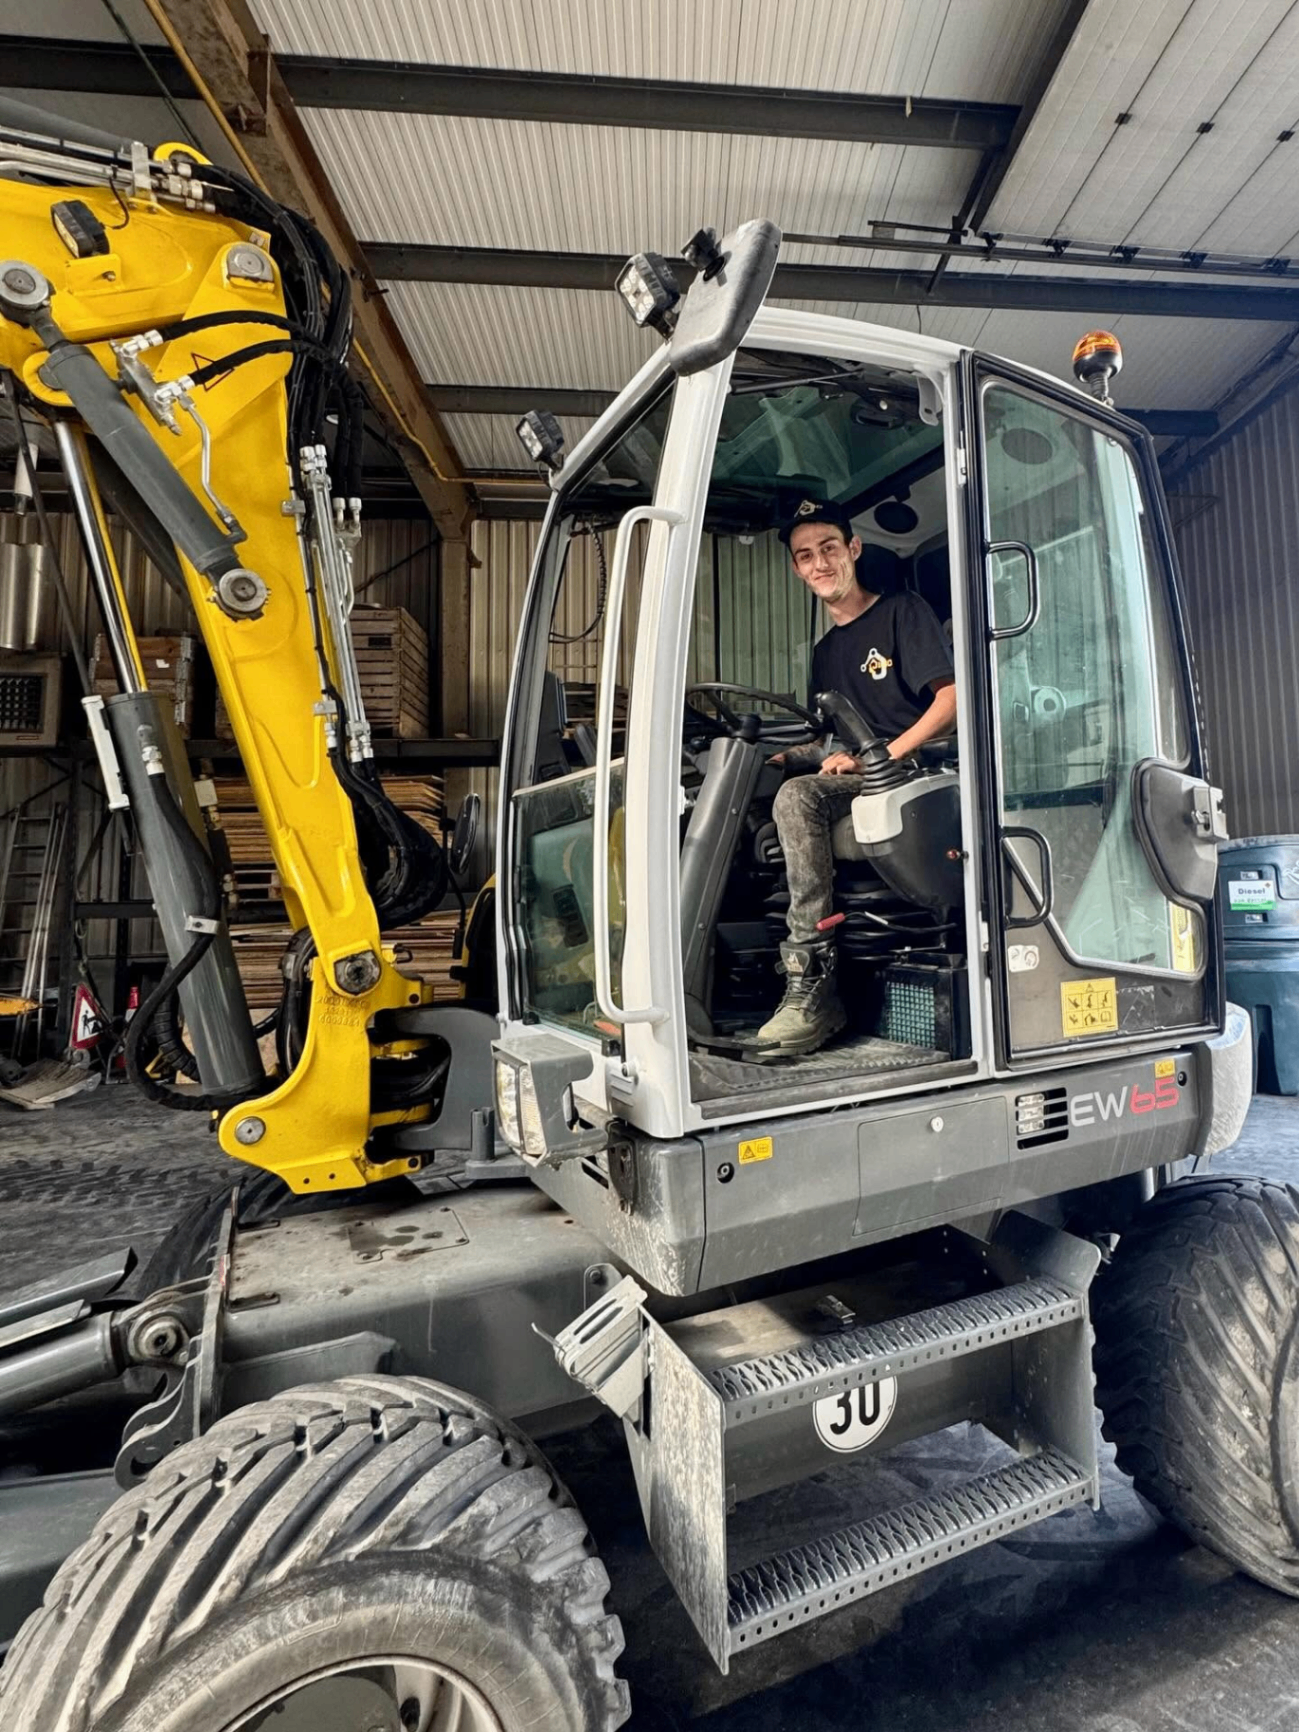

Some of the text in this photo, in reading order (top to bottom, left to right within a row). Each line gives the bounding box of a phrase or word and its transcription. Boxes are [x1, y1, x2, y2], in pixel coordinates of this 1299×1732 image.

[1237, 887, 1266, 895] Diesel
[1070, 1076, 1179, 1127] EW65
[829, 1381, 880, 1435] 30
